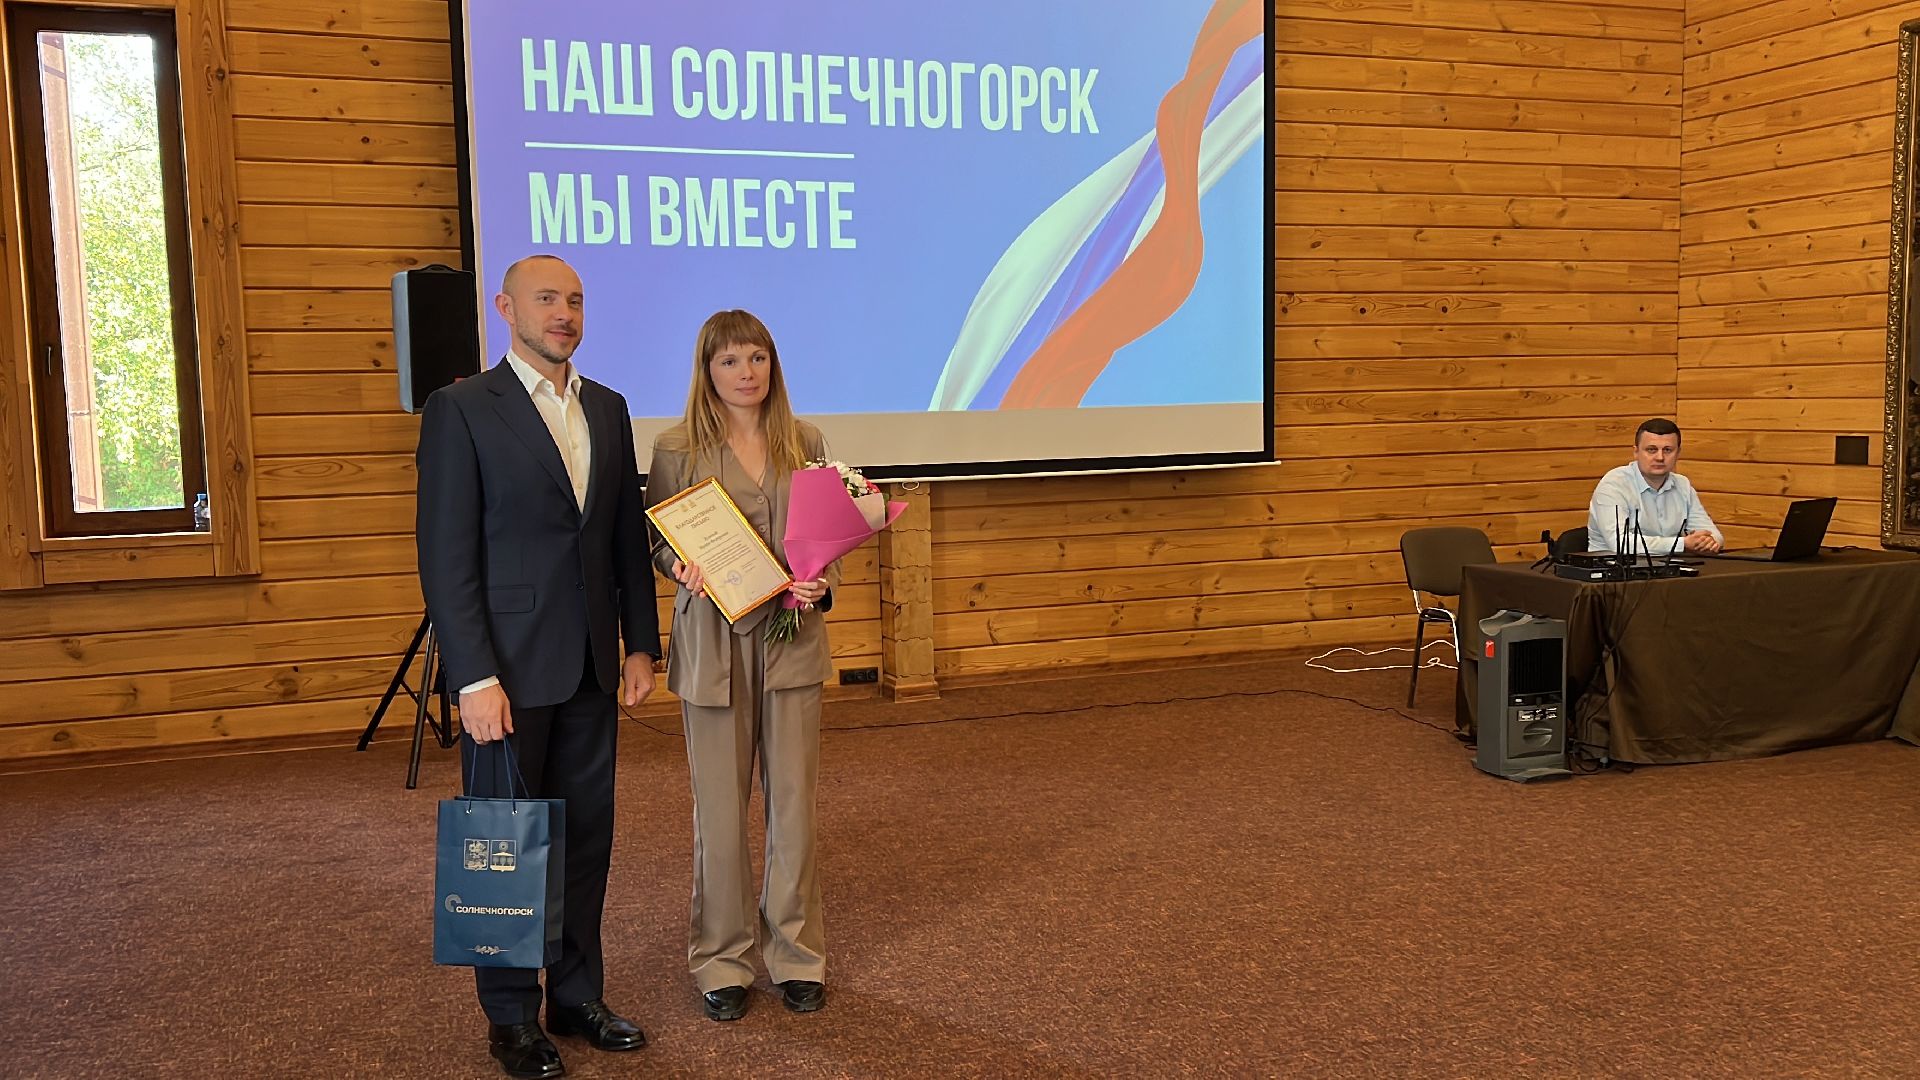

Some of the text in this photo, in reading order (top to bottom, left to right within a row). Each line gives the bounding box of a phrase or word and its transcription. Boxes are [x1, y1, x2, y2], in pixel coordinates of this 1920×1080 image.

[521, 38, 1100, 133] НАШ СОЛНЕЧНОГОРСК
[528, 172, 857, 249] МЫ ВМЕСТЕ
[455, 905, 534, 916] СОЛНЕЧНОГОРСК
